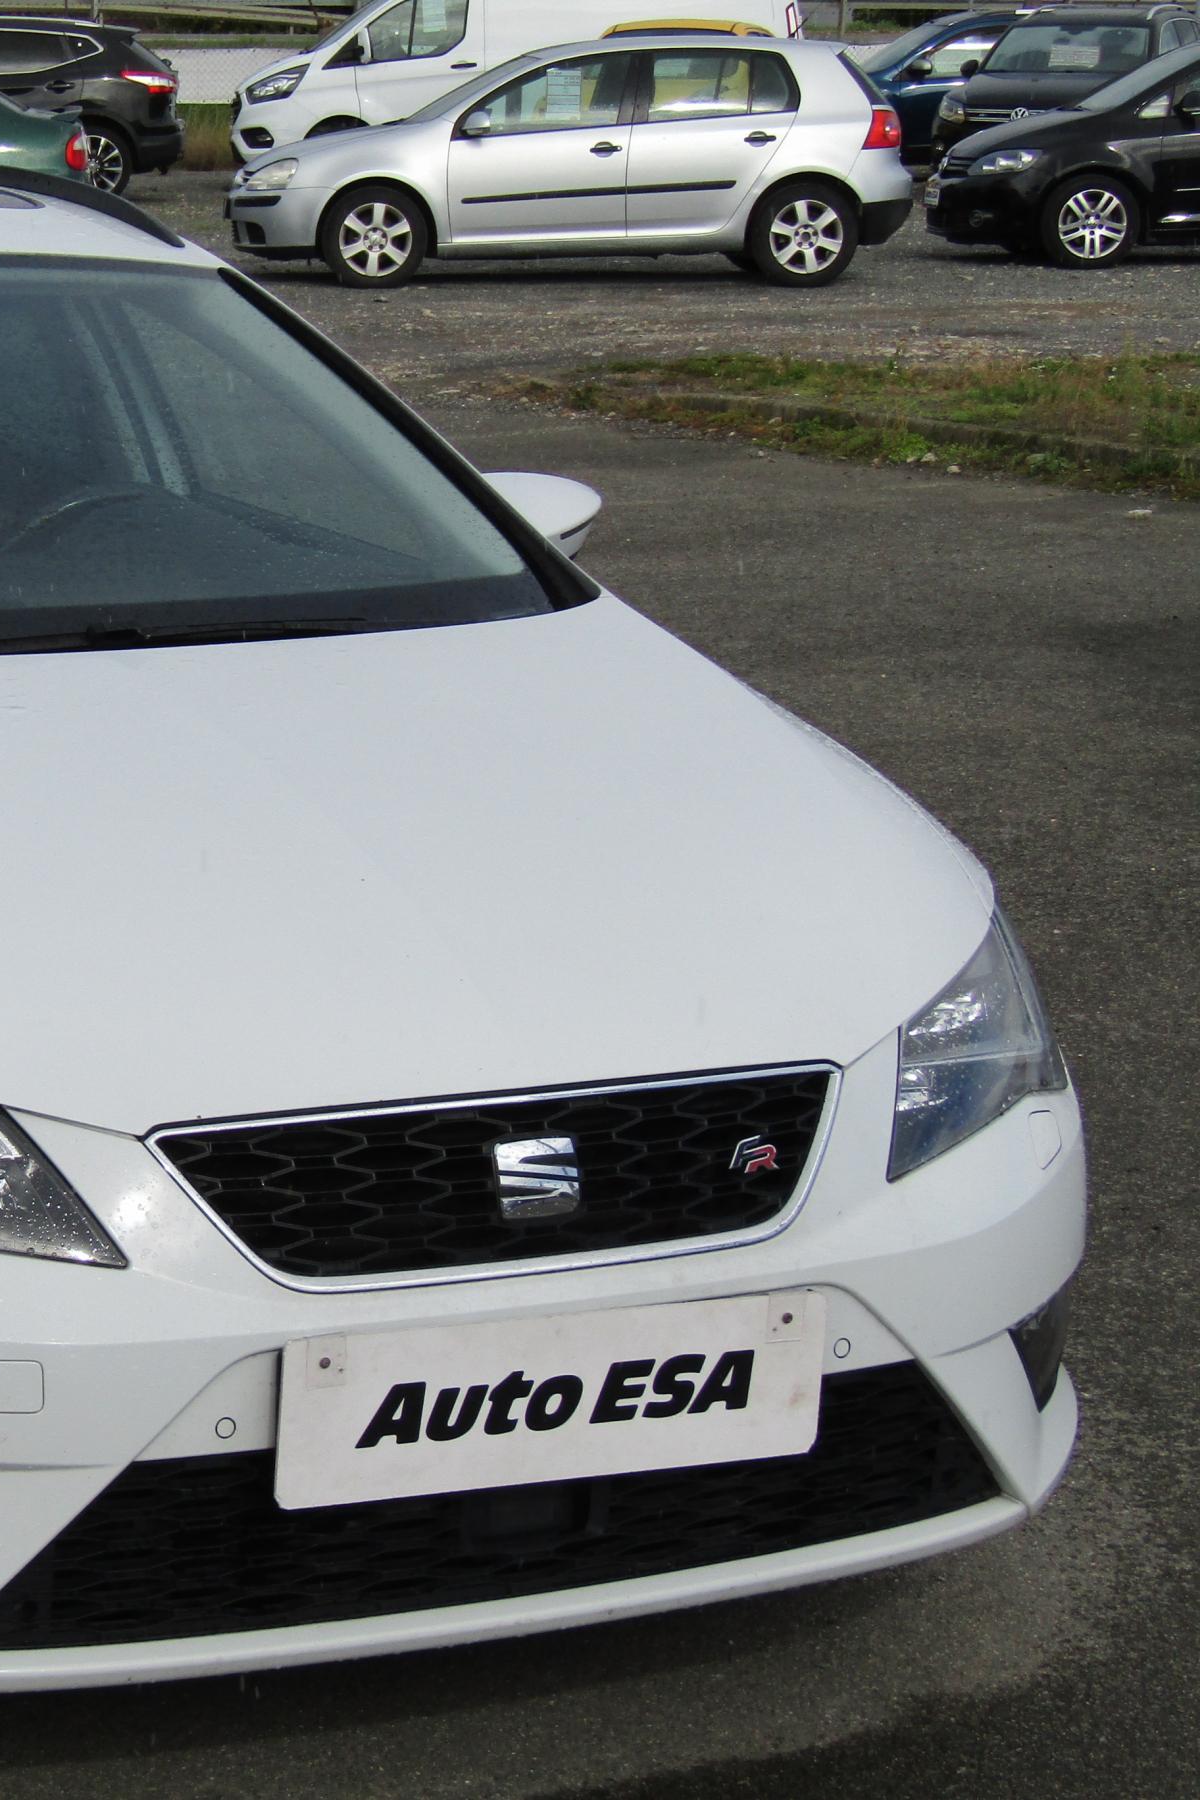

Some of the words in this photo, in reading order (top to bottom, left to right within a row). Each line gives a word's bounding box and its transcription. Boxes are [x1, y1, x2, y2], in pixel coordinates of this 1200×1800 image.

[728, 1134, 780, 1174] FR
[355, 1370, 584, 1449] Auto
[589, 1349, 756, 1424] ESA
